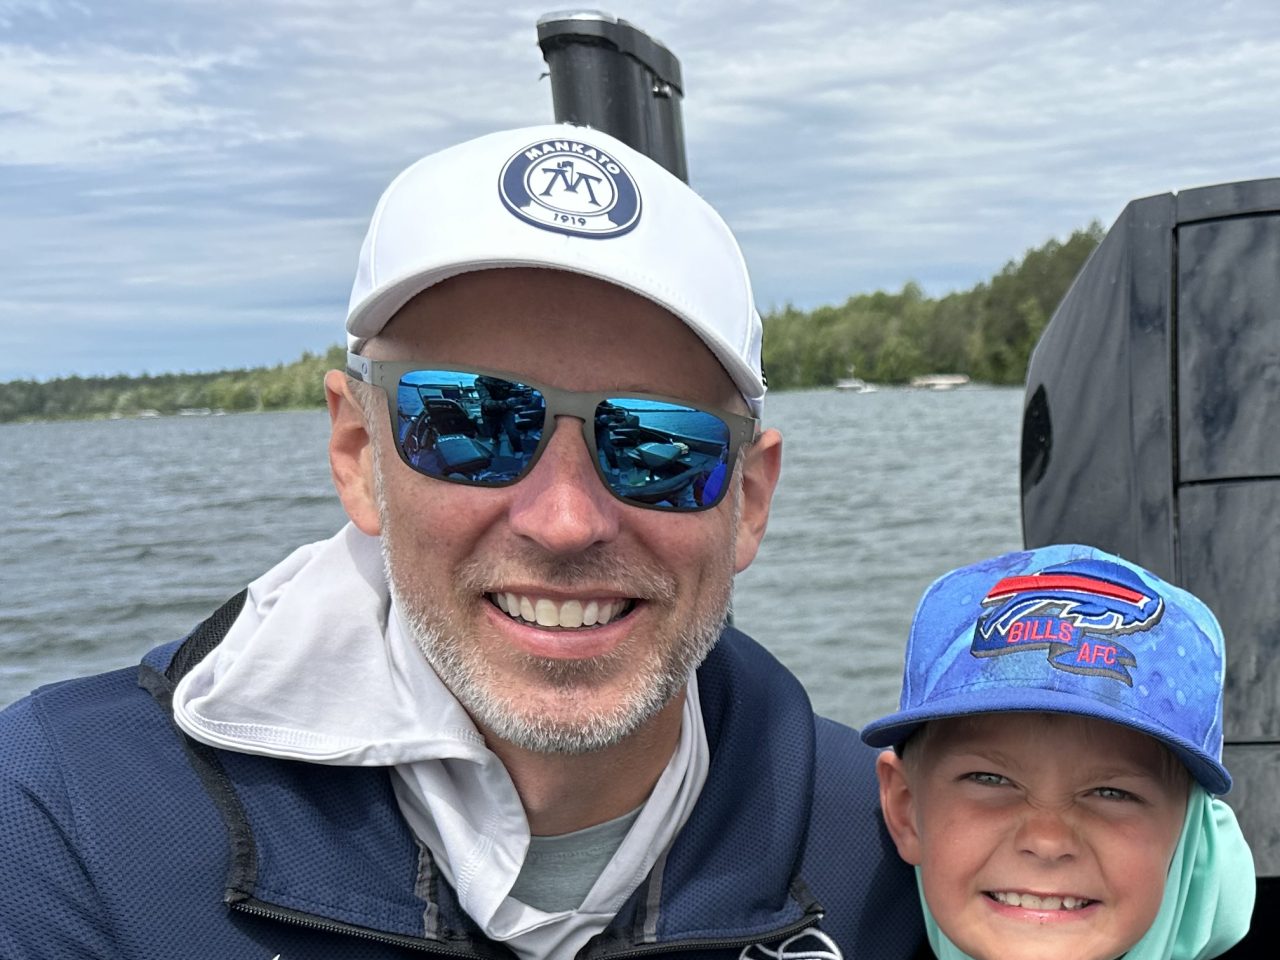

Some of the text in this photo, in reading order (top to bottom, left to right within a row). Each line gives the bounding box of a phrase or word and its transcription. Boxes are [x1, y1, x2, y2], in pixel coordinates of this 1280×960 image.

[525, 141, 621, 175] MANKATO
[554, 213, 586, 226] 1919
[1008, 621, 1073, 643] BILLS
[1077, 643, 1117, 664] AFC
